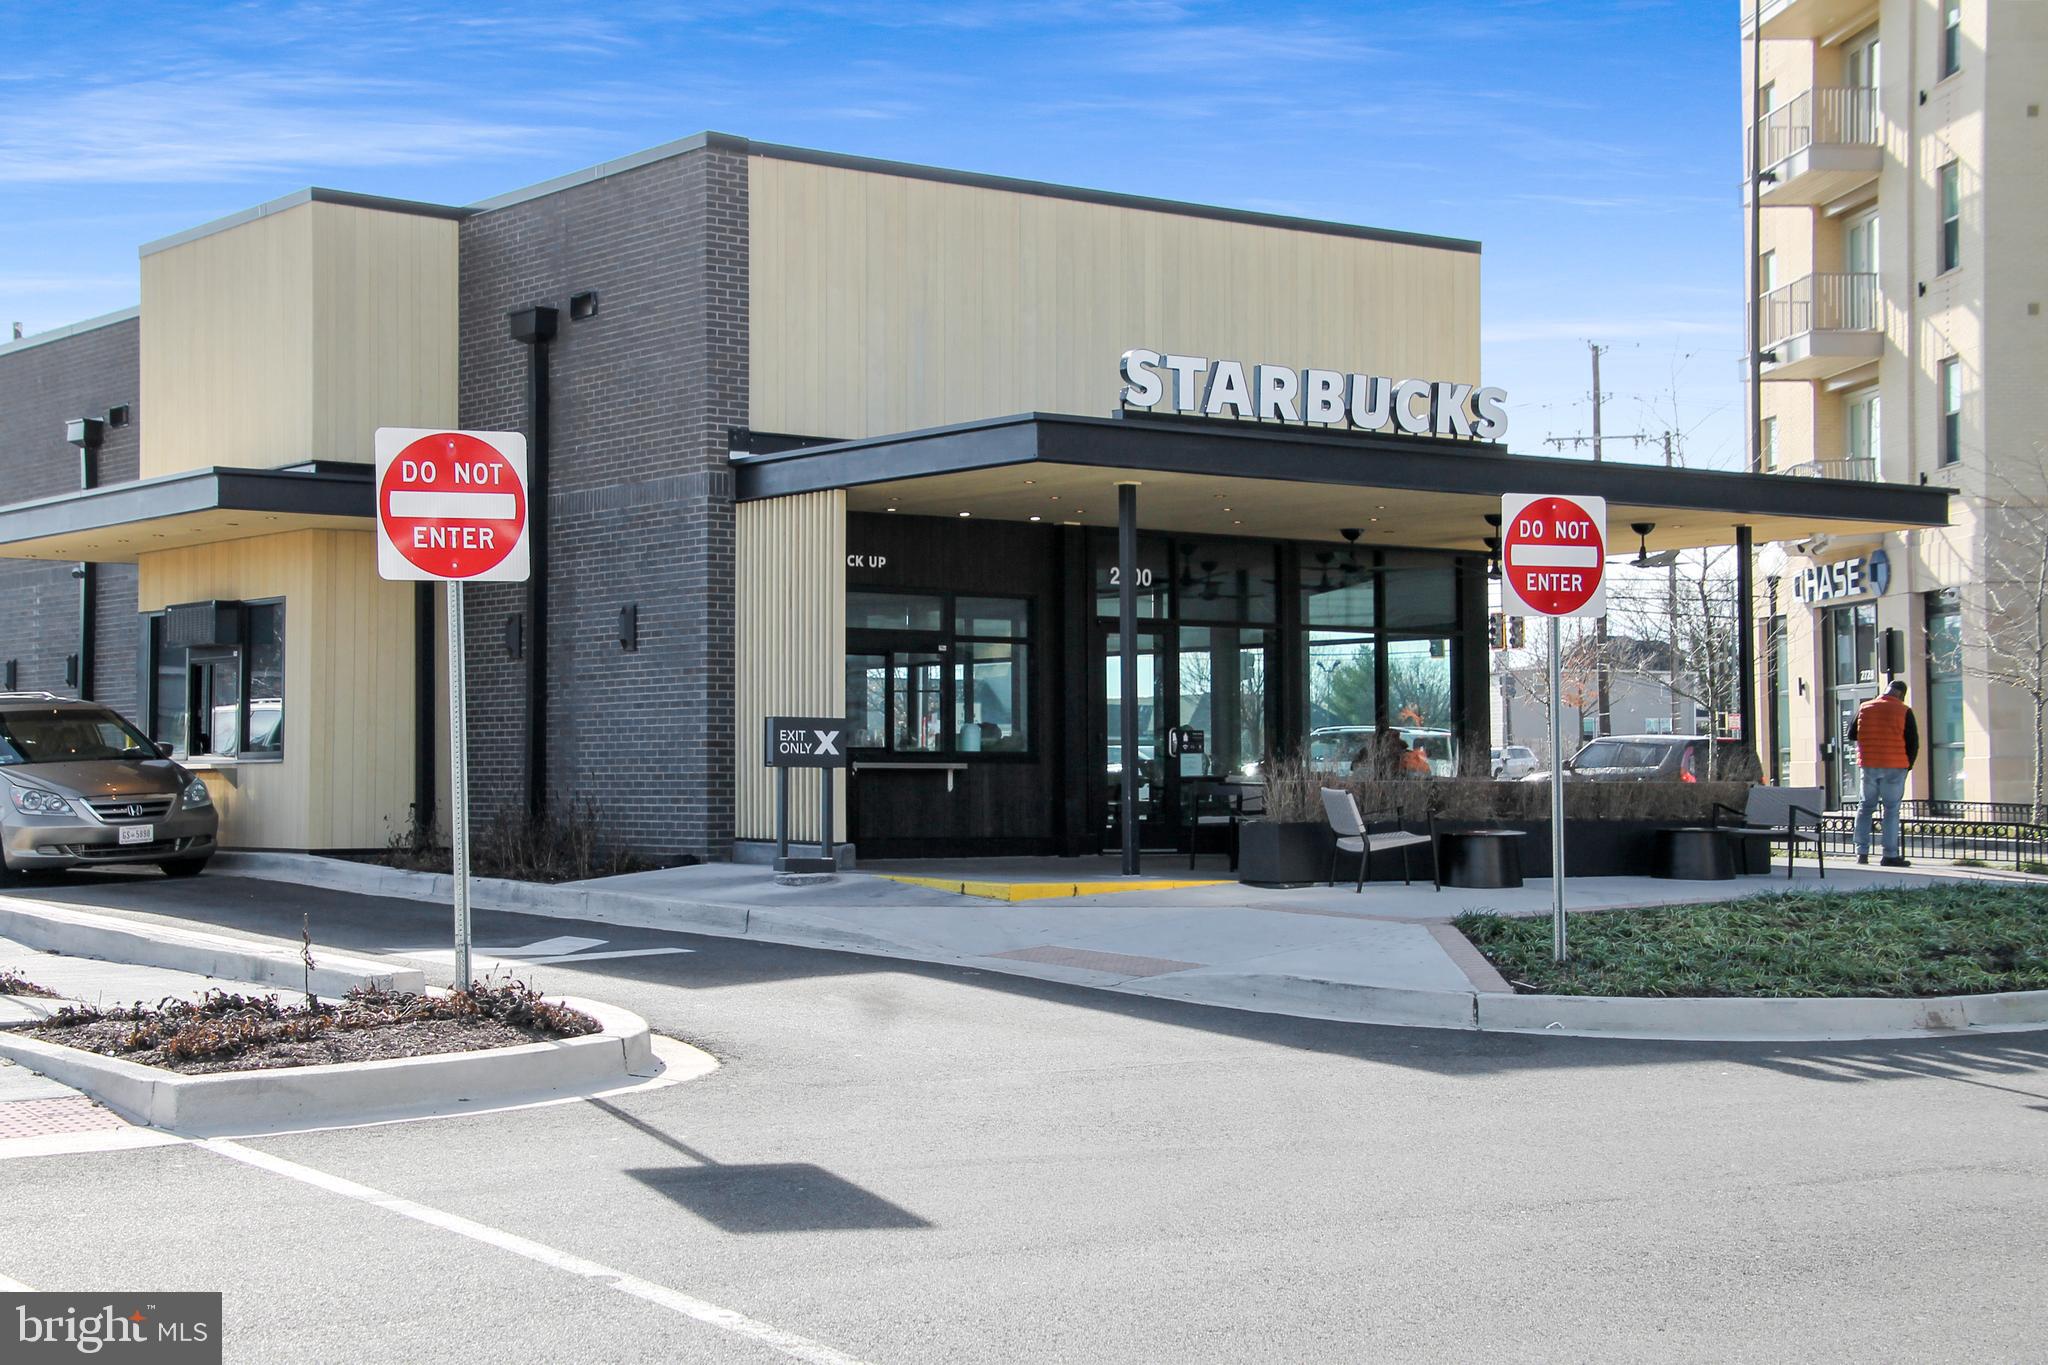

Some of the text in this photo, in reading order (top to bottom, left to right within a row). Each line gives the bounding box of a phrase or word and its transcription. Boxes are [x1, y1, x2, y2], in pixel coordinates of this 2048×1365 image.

[1119, 348, 1508, 439] STARBUCKS
[402, 460, 503, 485] DO NOT
[413, 526, 495, 549] ENTER
[1519, 519, 1589, 540] DO NOT
[847, 554, 886, 568] CK UP
[1110, 566, 1152, 587] 200
[1526, 572, 1583, 592] ENTER
[1792, 557, 1864, 603] CHASE
[780, 729, 806, 741] EXIT
[780, 742, 812, 754] ONLY
